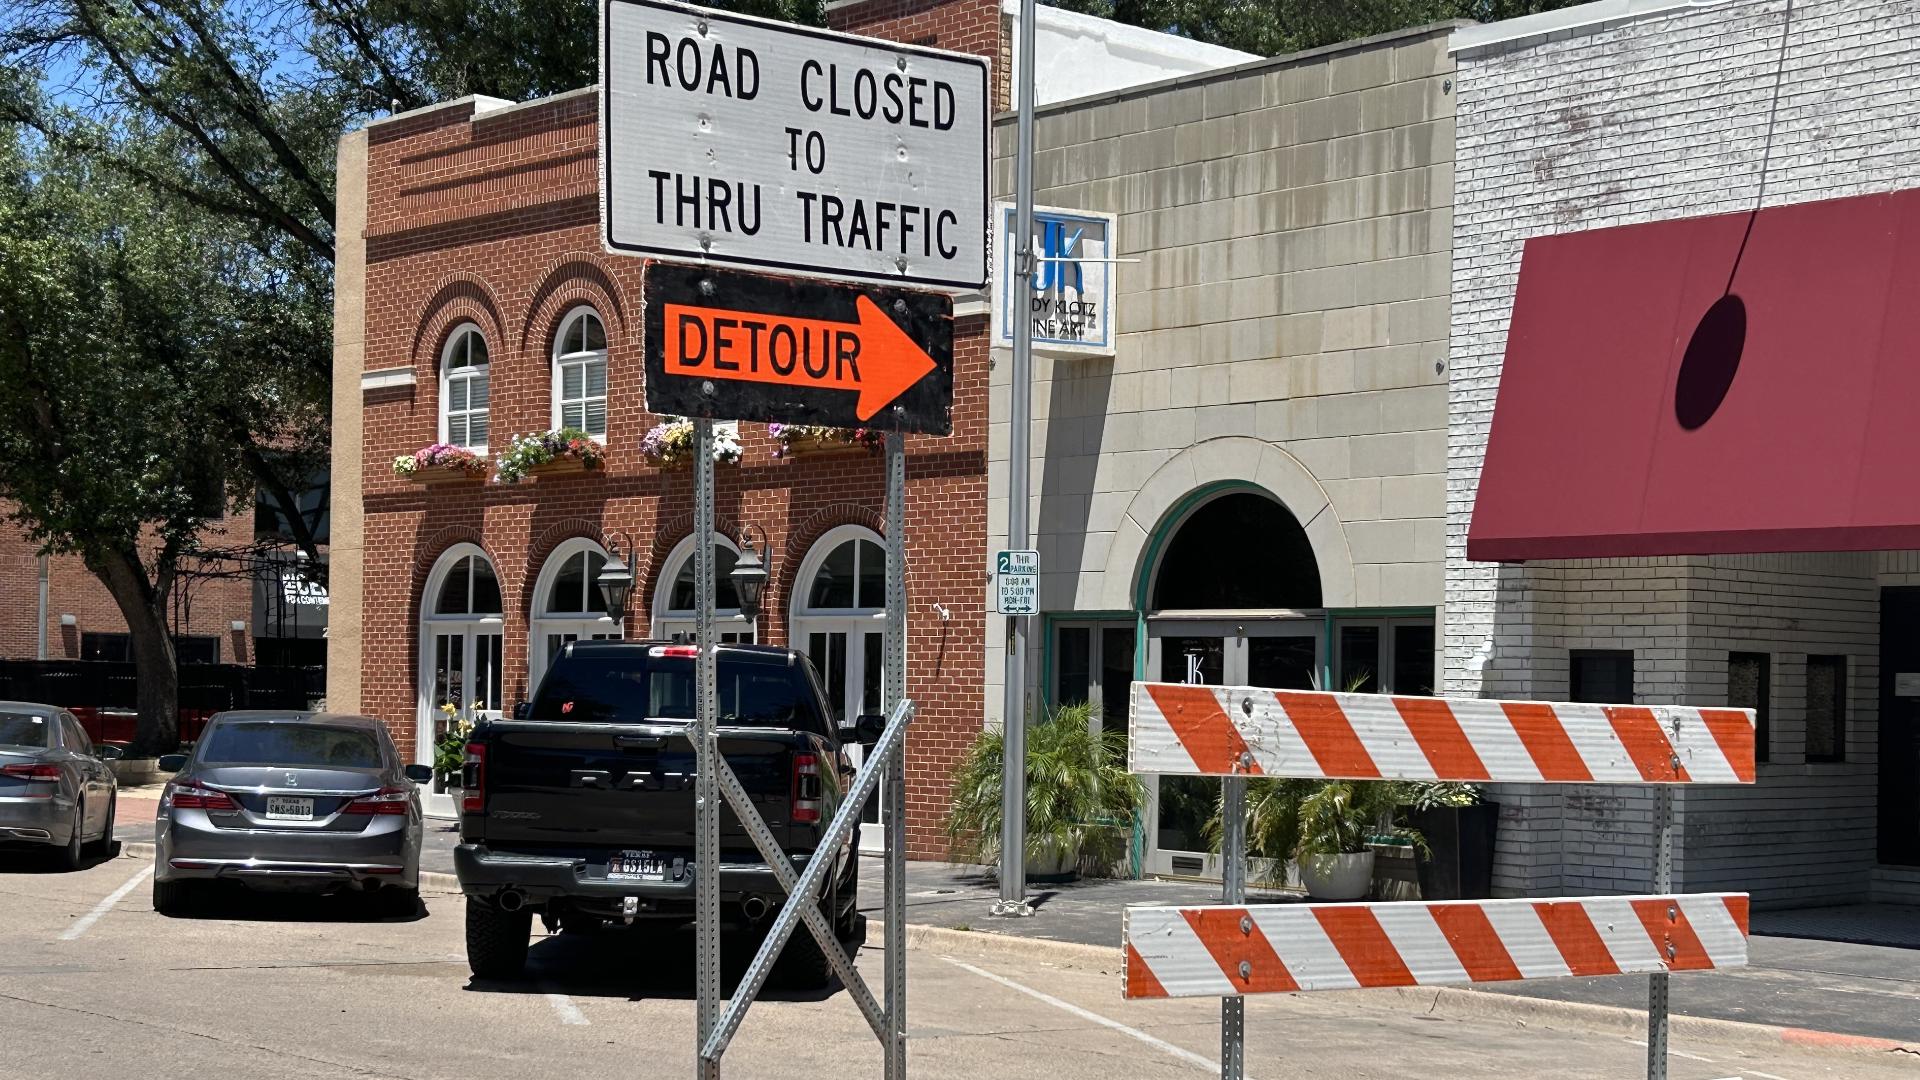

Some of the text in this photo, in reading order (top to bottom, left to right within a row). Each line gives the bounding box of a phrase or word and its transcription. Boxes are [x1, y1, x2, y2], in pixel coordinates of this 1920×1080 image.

[646, 31, 955, 132] ROAD CLOSED
[785, 126, 826, 175] TO
[648, 169, 958, 260] THRU TRAFFIC
[1031, 298, 1097, 317] DY KLOTZ
[1032, 318, 1086, 337] INE ART
[678, 313, 862, 383] DETOUR
[999, 556, 1009, 573] 2
[1010, 565, 1037, 574] PARKING
